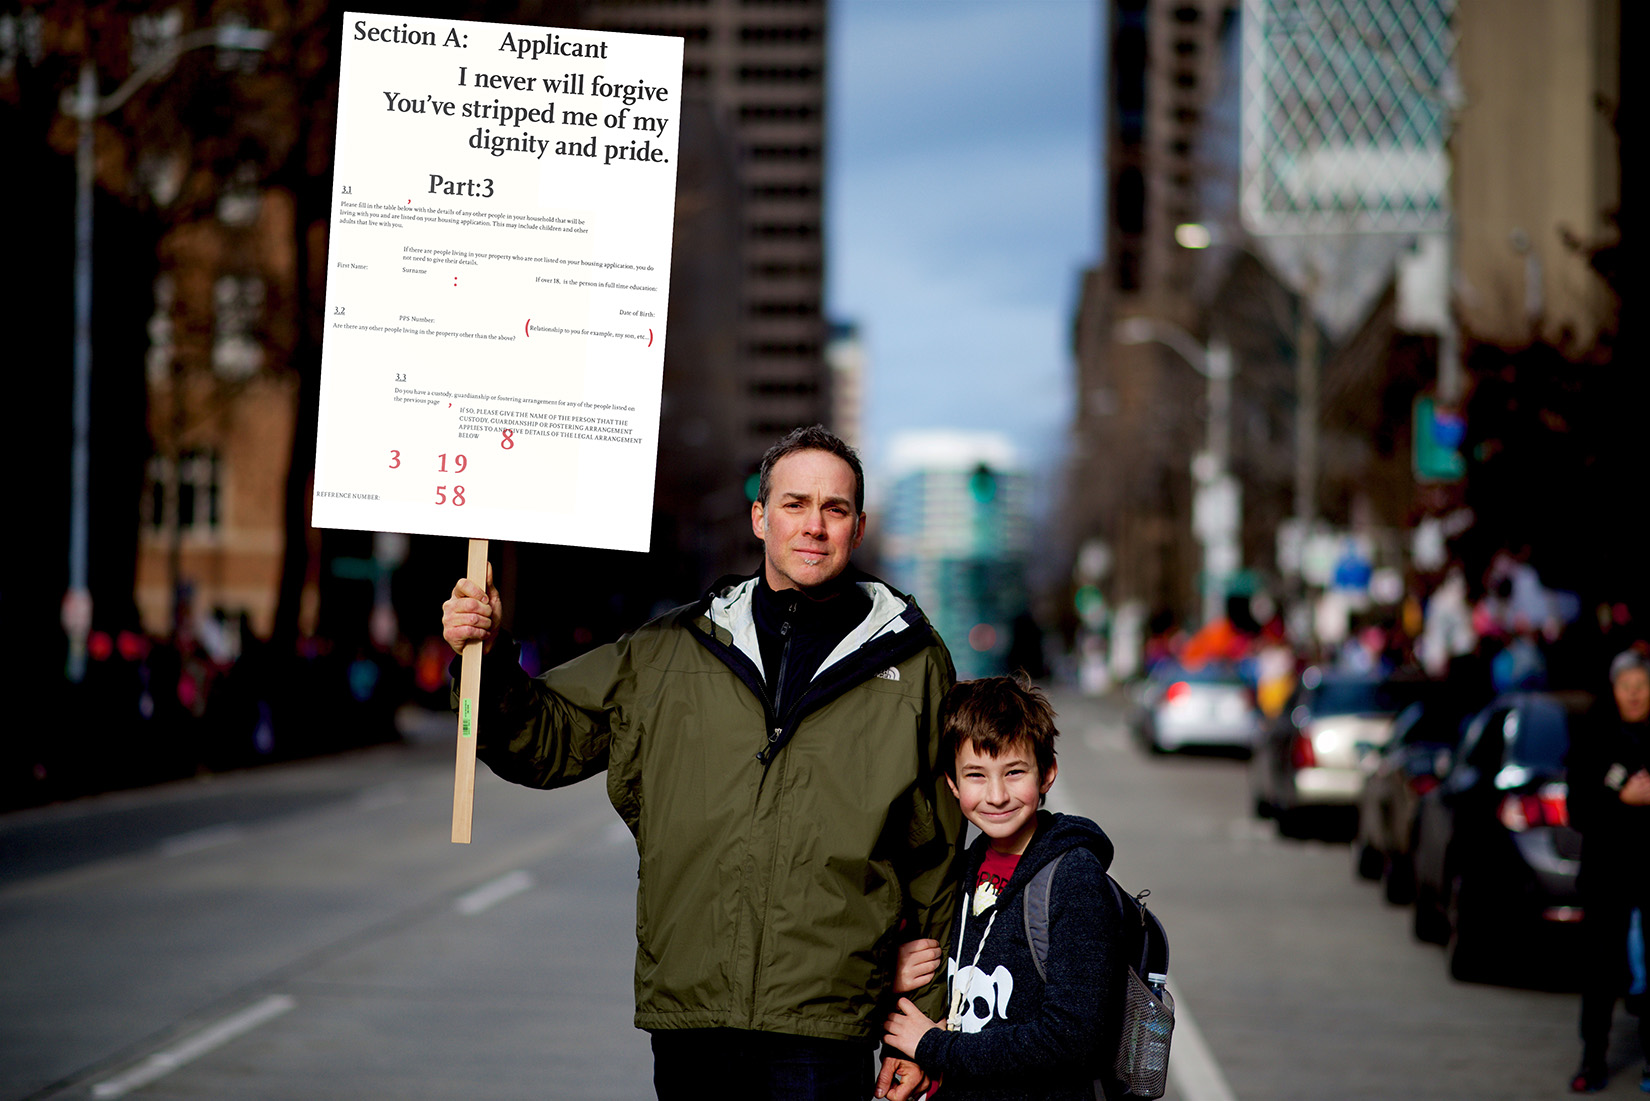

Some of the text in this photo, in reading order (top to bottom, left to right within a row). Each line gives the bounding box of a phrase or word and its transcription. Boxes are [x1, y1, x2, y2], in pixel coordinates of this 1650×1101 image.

[354, 21, 468, 48] Section A:
[498, 32, 608, 60] Applicant
[458, 67, 668, 106] I never will forgive
[462, 99, 555, 128] stripped
[562, 111, 598, 127] me
[604, 108, 631, 129] of
[633, 116, 669, 138] my
[469, 127, 669, 165] dignity and pride.
[342, 186, 352, 194] 3.1
[428, 174, 494, 198] Part:3
[340, 209, 356, 217] living
[581, 260, 603, 268] housing
[334, 306, 345, 315] 3.2
[395, 373, 406, 382] 3.3
[454, 393, 490, 401] guardianship
[497, 395, 521, 403] fostering
[490, 418, 538, 427] GUARDIANSHIP
[585, 426, 632, 435] ARRANGEMENT
[501, 428, 515, 450] 8
[595, 435, 642, 444] ARRANGEMENT
[389, 450, 400, 469] 3
